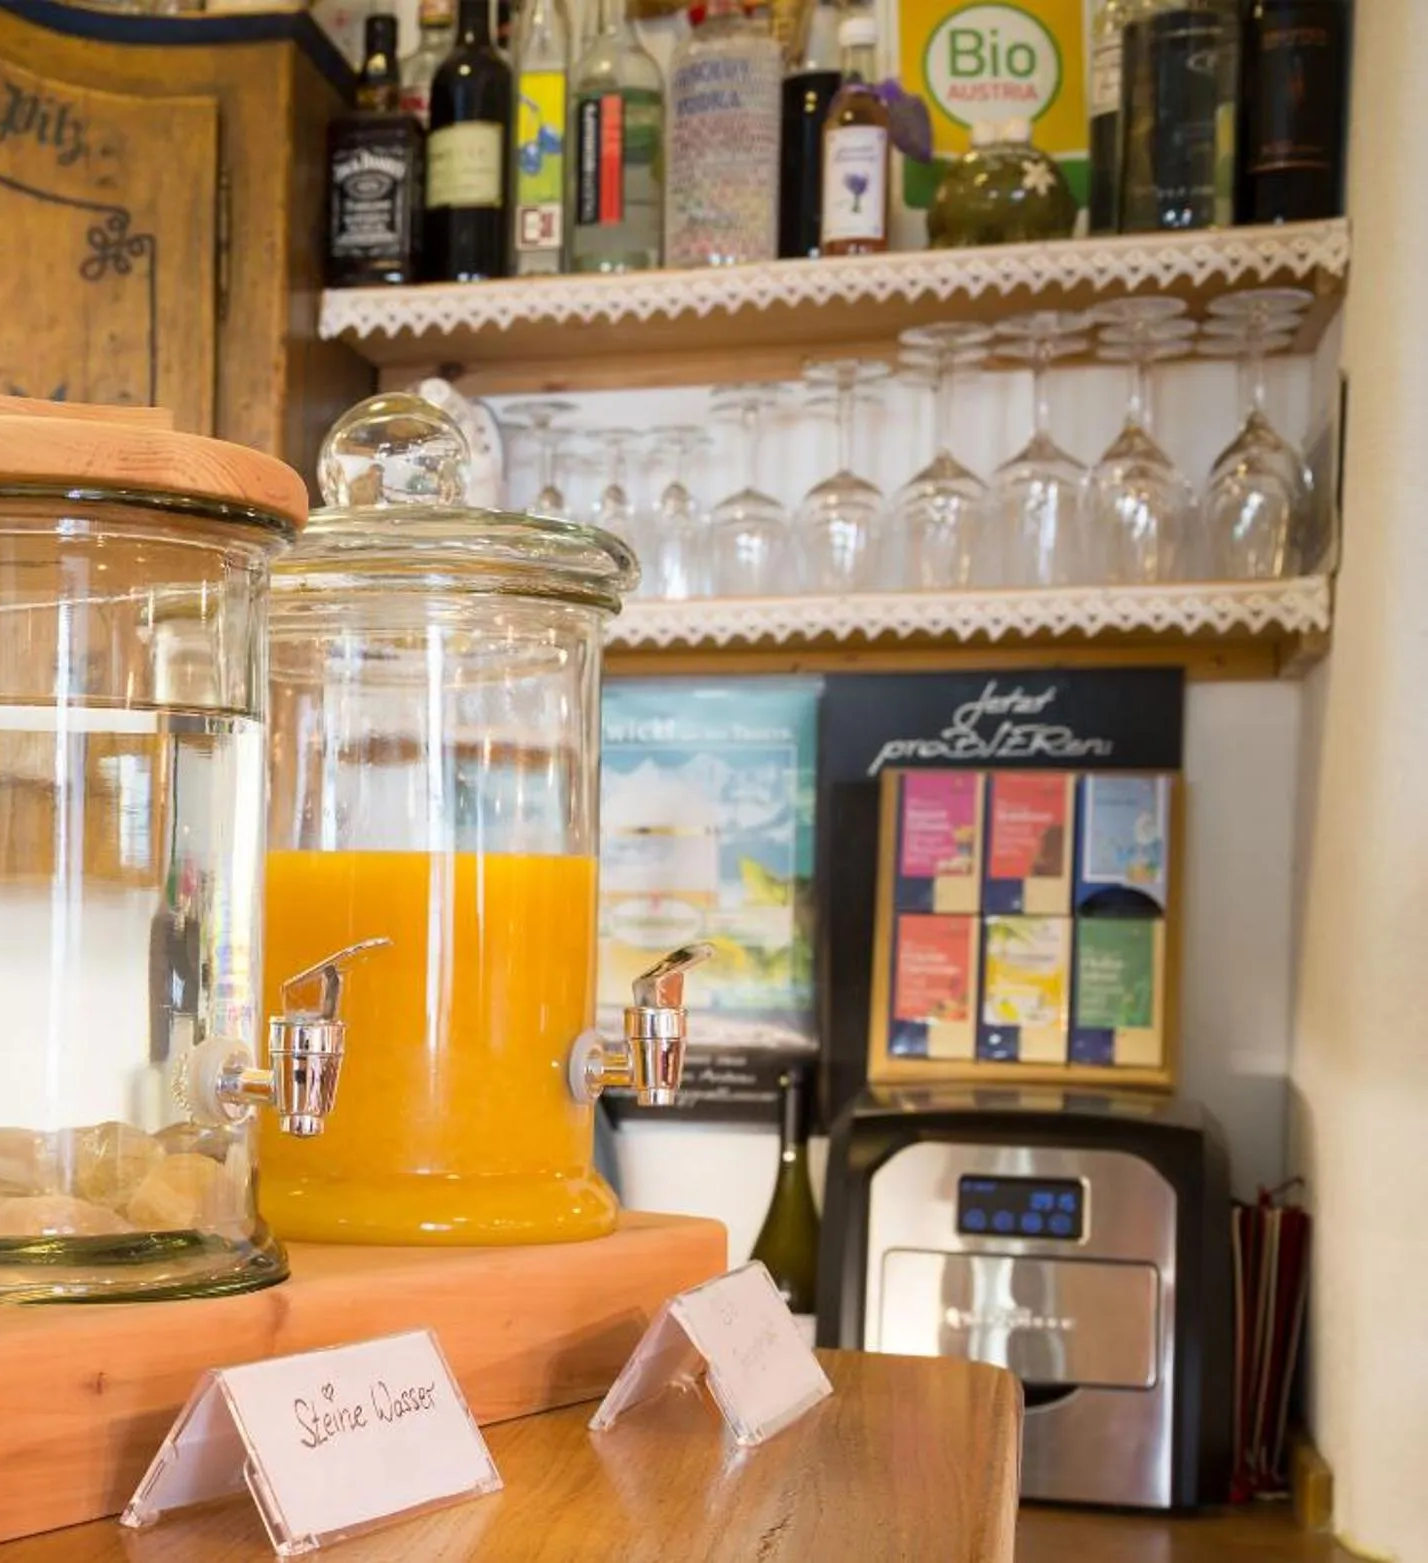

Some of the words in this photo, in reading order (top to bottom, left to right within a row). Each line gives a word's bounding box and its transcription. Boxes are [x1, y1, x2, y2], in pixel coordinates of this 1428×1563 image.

[948, 27, 1037, 78] Bio
[947, 82, 1039, 101] AUSTRIA
[952, 678, 1059, 732] Jetzt
[293, 1382, 368, 1449] Steine
[370, 1377, 436, 1423] Wasser
